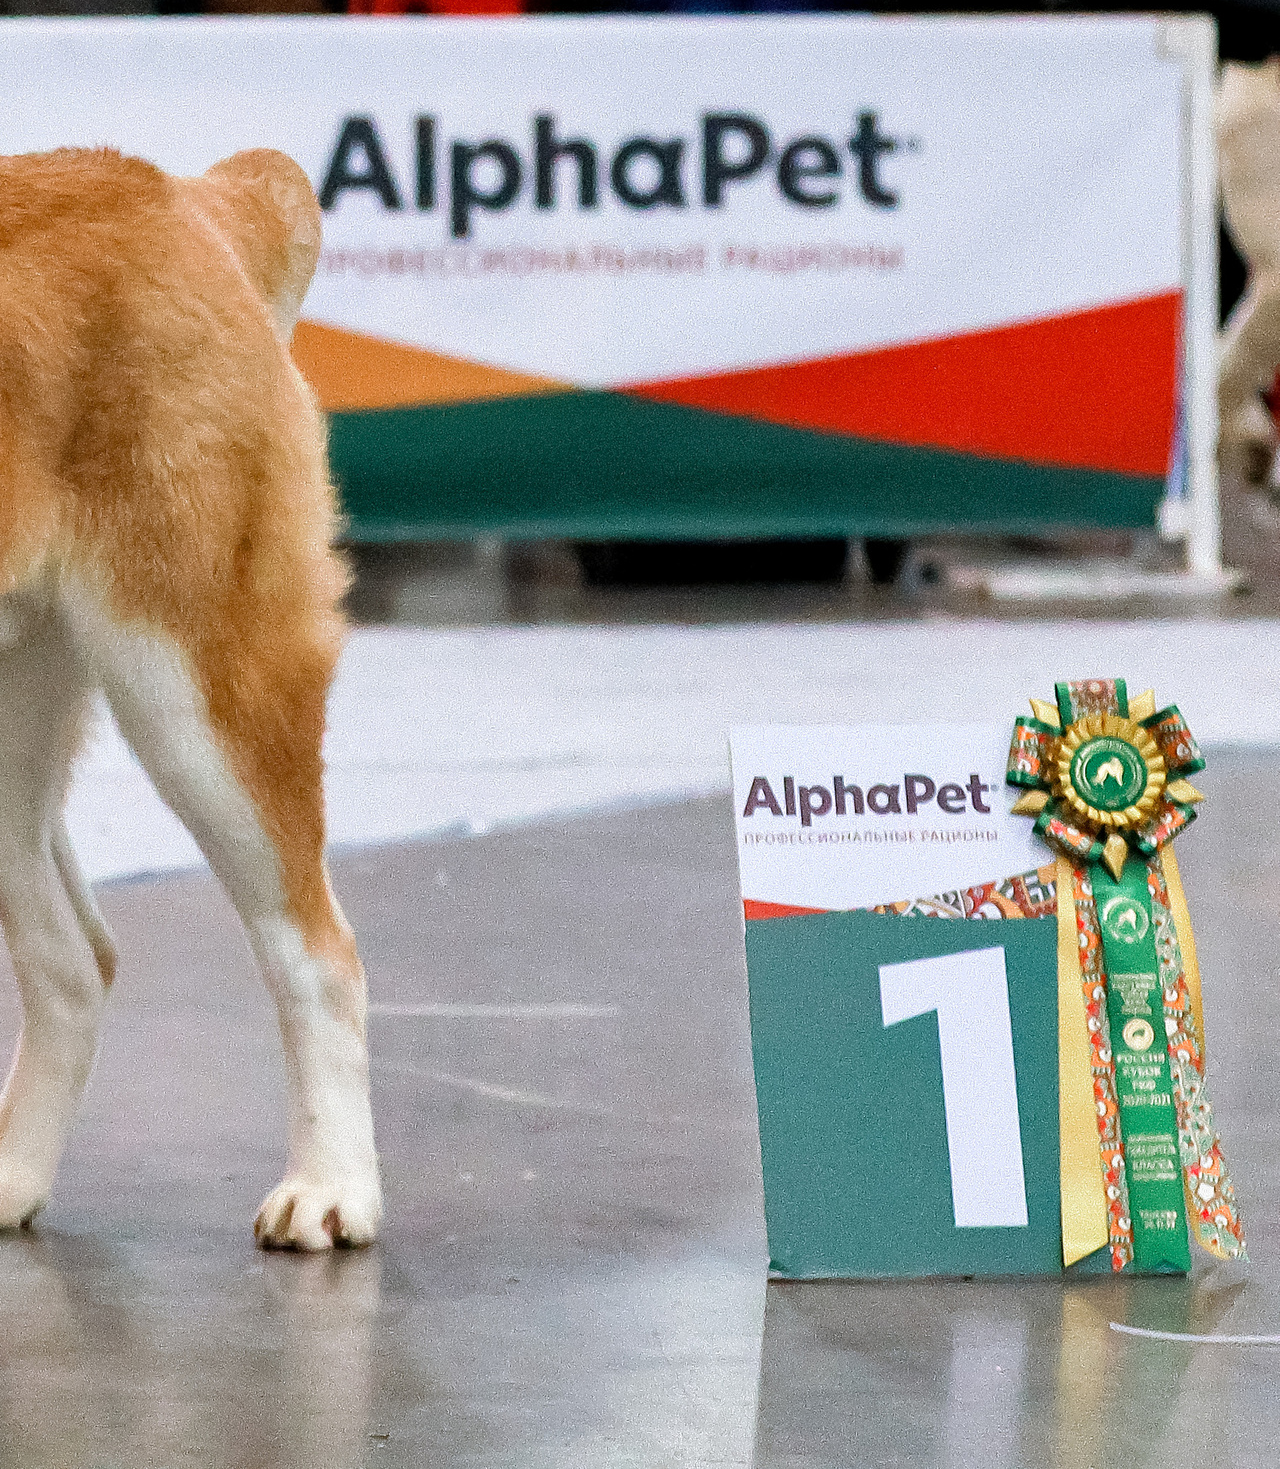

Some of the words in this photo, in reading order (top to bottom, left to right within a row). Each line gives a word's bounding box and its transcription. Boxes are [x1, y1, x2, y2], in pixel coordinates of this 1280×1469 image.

[318, 112, 901, 237] AlphaPet
[723, 243, 905, 273] РАЦИОНЫ
[742, 774, 991, 826] AlphaPet
[744, 831, 914, 845] ПРОФЕССИОНАЛЬНЫЕ
[920, 830, 999, 843] РАЦИОНЫ
[879, 946, 1028, 1226] 1
